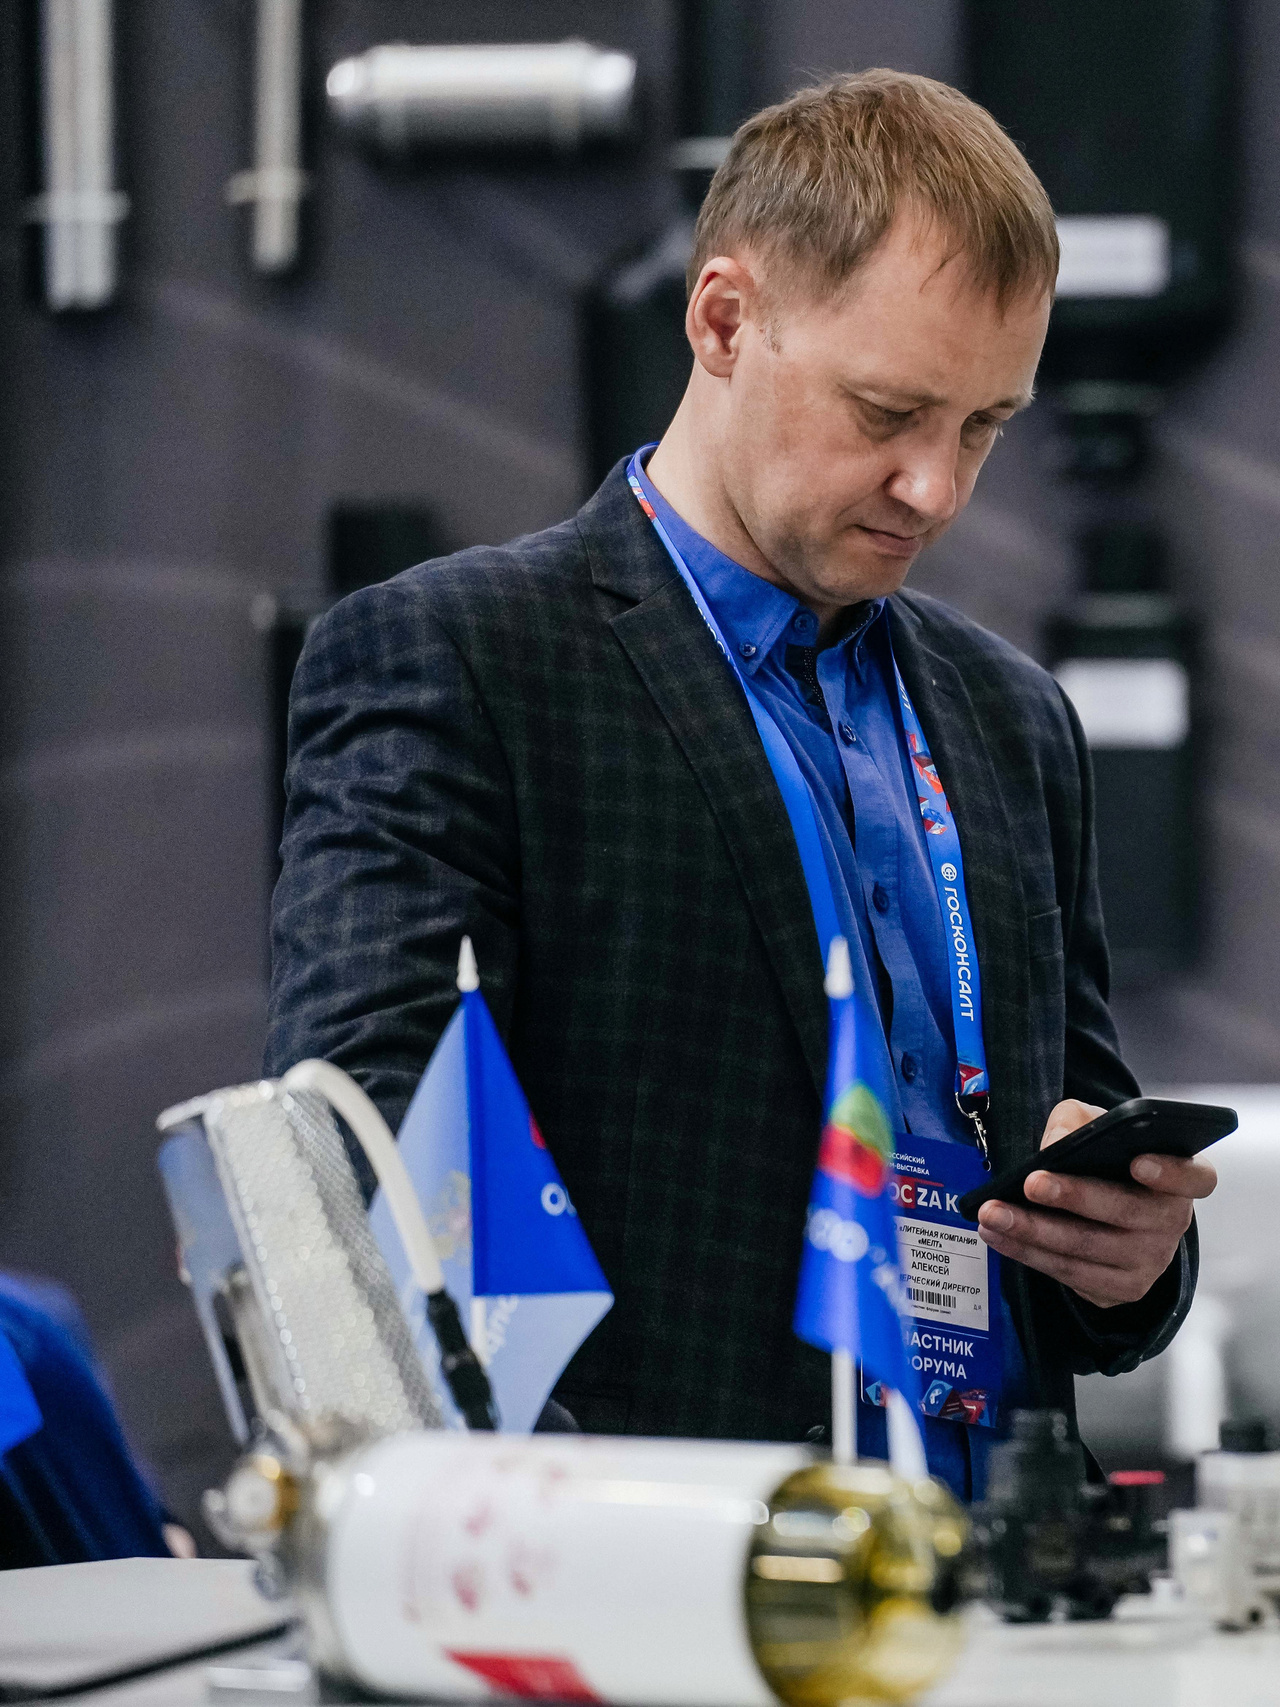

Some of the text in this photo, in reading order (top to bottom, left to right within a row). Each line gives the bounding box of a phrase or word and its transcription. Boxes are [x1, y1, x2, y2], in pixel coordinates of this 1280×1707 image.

[944, 886, 974, 1022] ГОСКОНСАЛТ
[888, 1152, 926, 1165] ОССИЙСКИЙ
[939, 1232, 978, 1246] КОМПАНИЯ
[911, 1249, 950, 1264] ТИХОНОВ
[911, 1261, 950, 1276] АЛЕКСЕЙ
[900, 1273, 981, 1296] ЕРЧЕСКИЙ ДИРЕКТОР
[907, 1355, 967, 1380] ОРУМА
